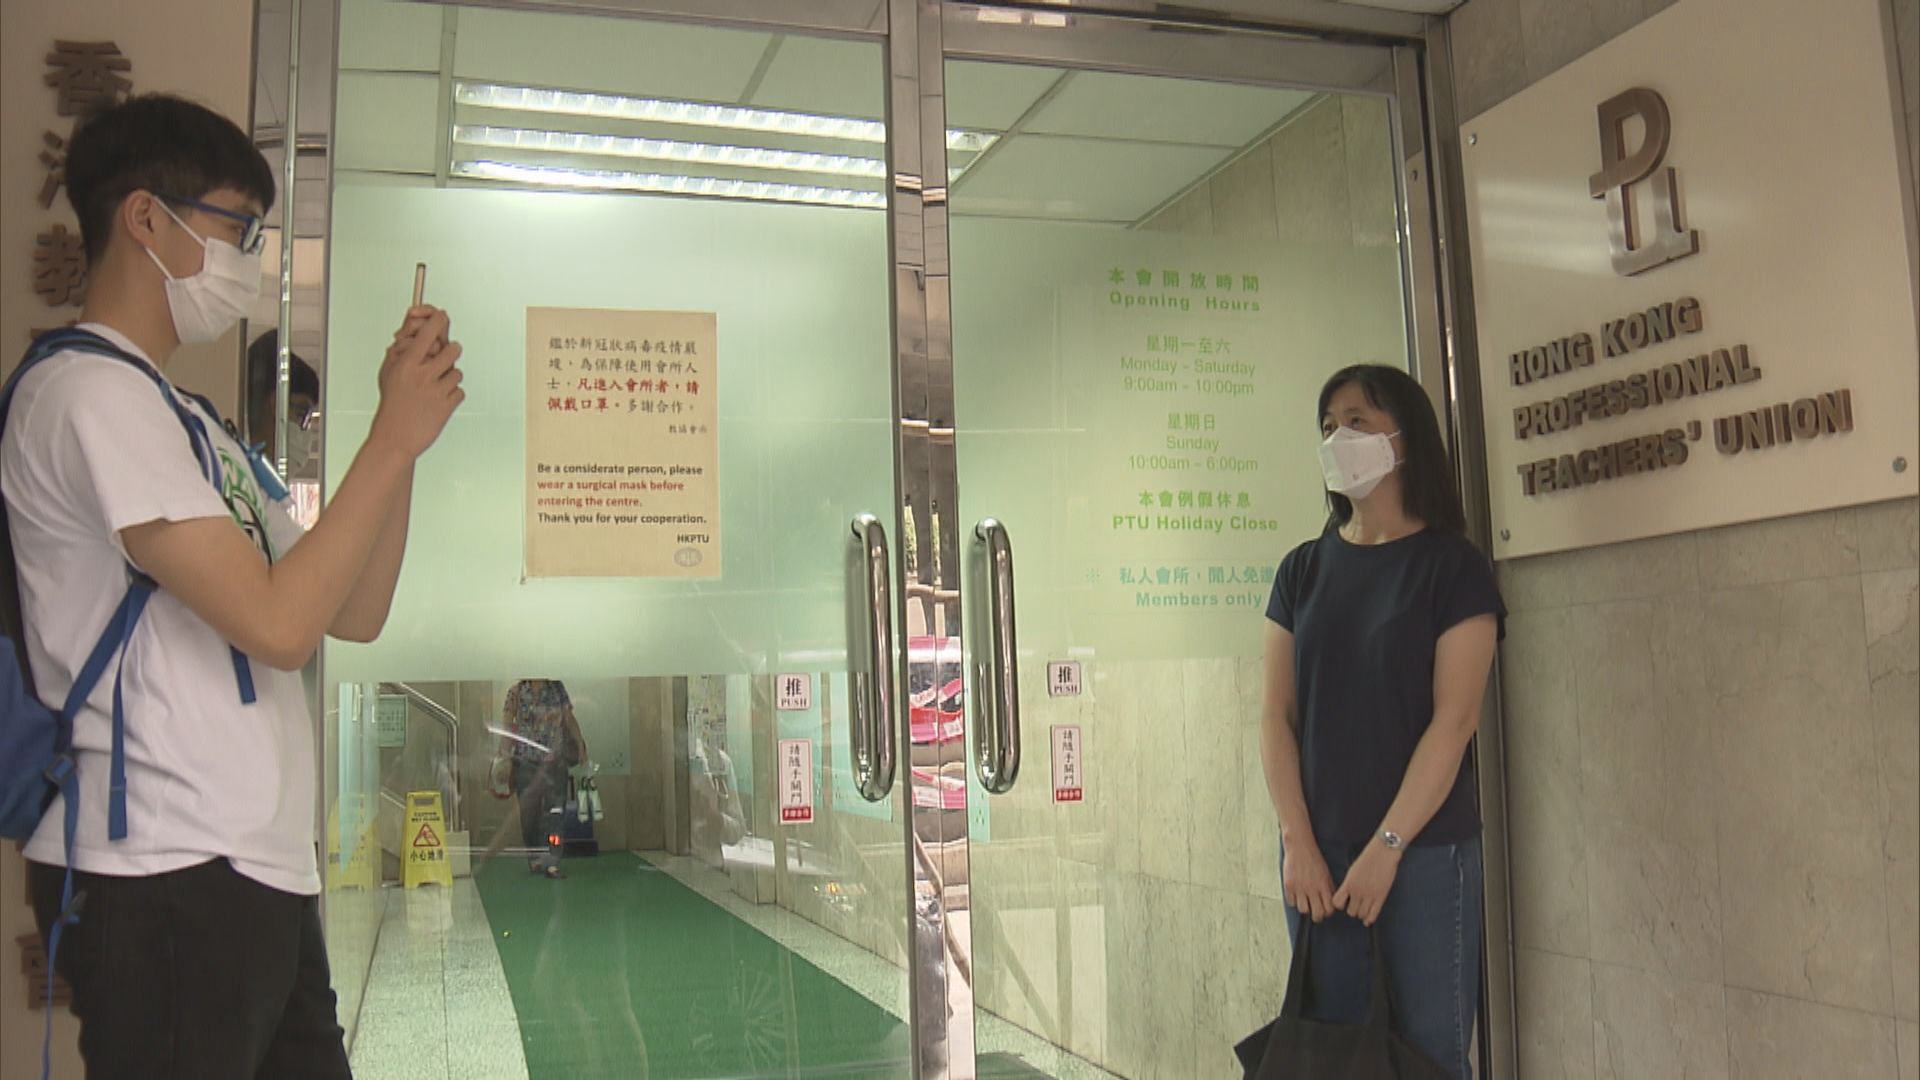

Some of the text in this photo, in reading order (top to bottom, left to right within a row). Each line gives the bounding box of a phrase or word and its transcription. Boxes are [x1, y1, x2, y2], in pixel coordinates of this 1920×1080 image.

[1108, 267, 1259, 293] 本會開放時間
[1109, 291, 1260, 311] Opening Hours
[1147, 335, 1231, 354] 星期一至六
[1509, 296, 1704, 386] HONG KONG
[1121, 357, 1178, 375] Monday
[1194, 359, 1256, 377] Saturday
[1123, 376, 1178, 392] 9:00am
[1196, 379, 1254, 396] 10:00pm
[1513, 343, 1763, 440] PROFESSIONAL
[1167, 412, 1216, 431] 星期日
[1166, 435, 1220, 453] Sunday
[1517, 388, 1854, 497] TEACHERS' UNION
[537, 463, 703, 476] Be a considerate person, please
[1129, 455, 1190, 470] 10:00am
[1206, 455, 1258, 474] 6:00pm
[537, 480, 684, 492] wear a surgical mask before
[537, 496, 642, 508] entering the centre.
[537, 512, 707, 525] Thank you for your cooperation.
[1112, 515, 1278, 533] PTU Holiday Close
[677, 534, 709, 544] HKPTU
[1135, 591, 1262, 609] Members only
[1058, 665, 1073, 684] 推
[785, 677, 803, 697] 推
[1054, 684, 1078, 694] PUSH
[781, 698, 807, 708] PUSH
